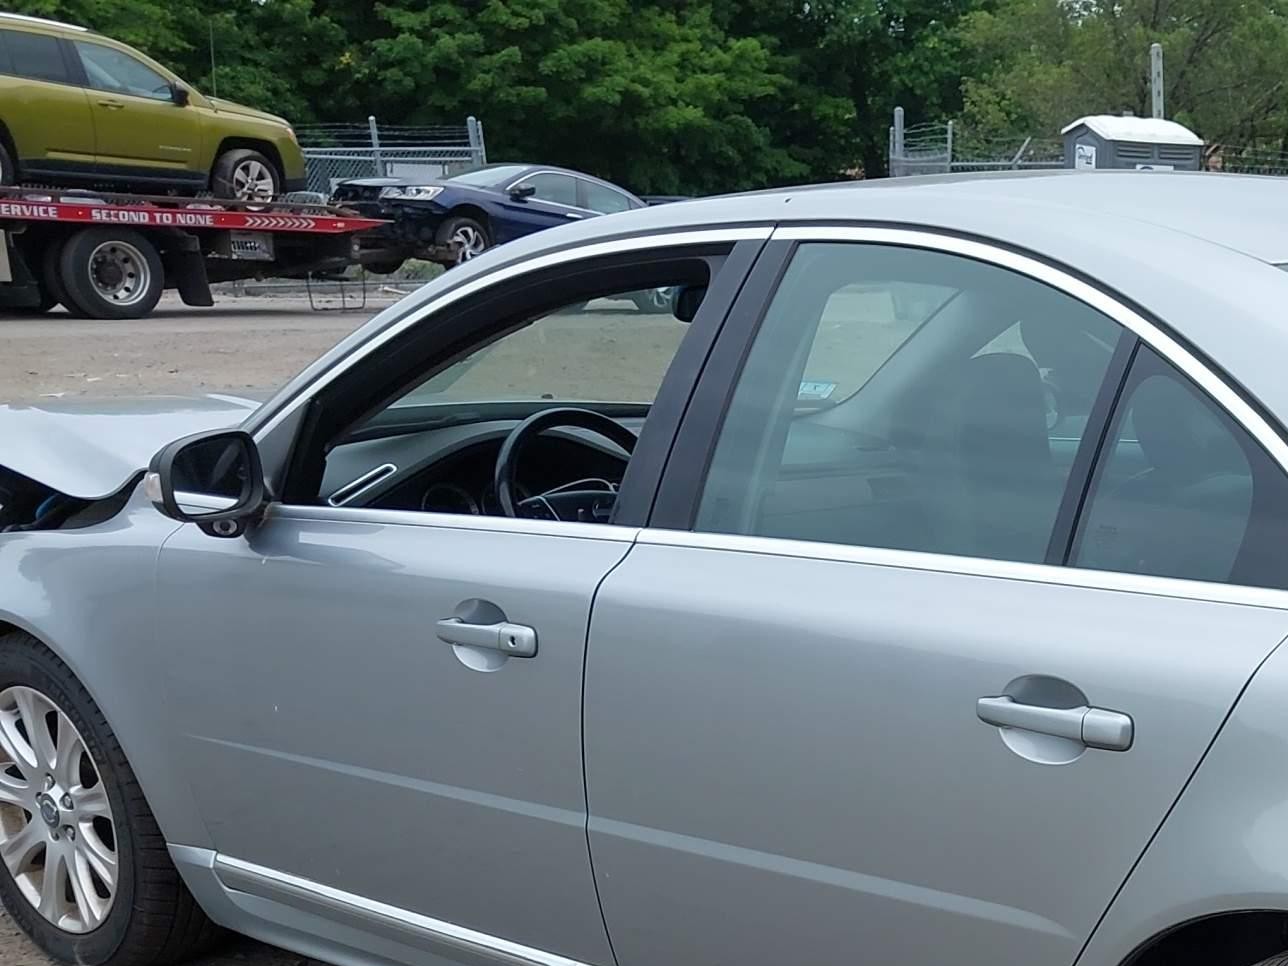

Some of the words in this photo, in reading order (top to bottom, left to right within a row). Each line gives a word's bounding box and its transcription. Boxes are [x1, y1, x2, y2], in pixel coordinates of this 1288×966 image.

[91, 208, 149, 223] SECOND
[154, 212, 172, 224] TO
[176, 213, 214, 226] NONE
